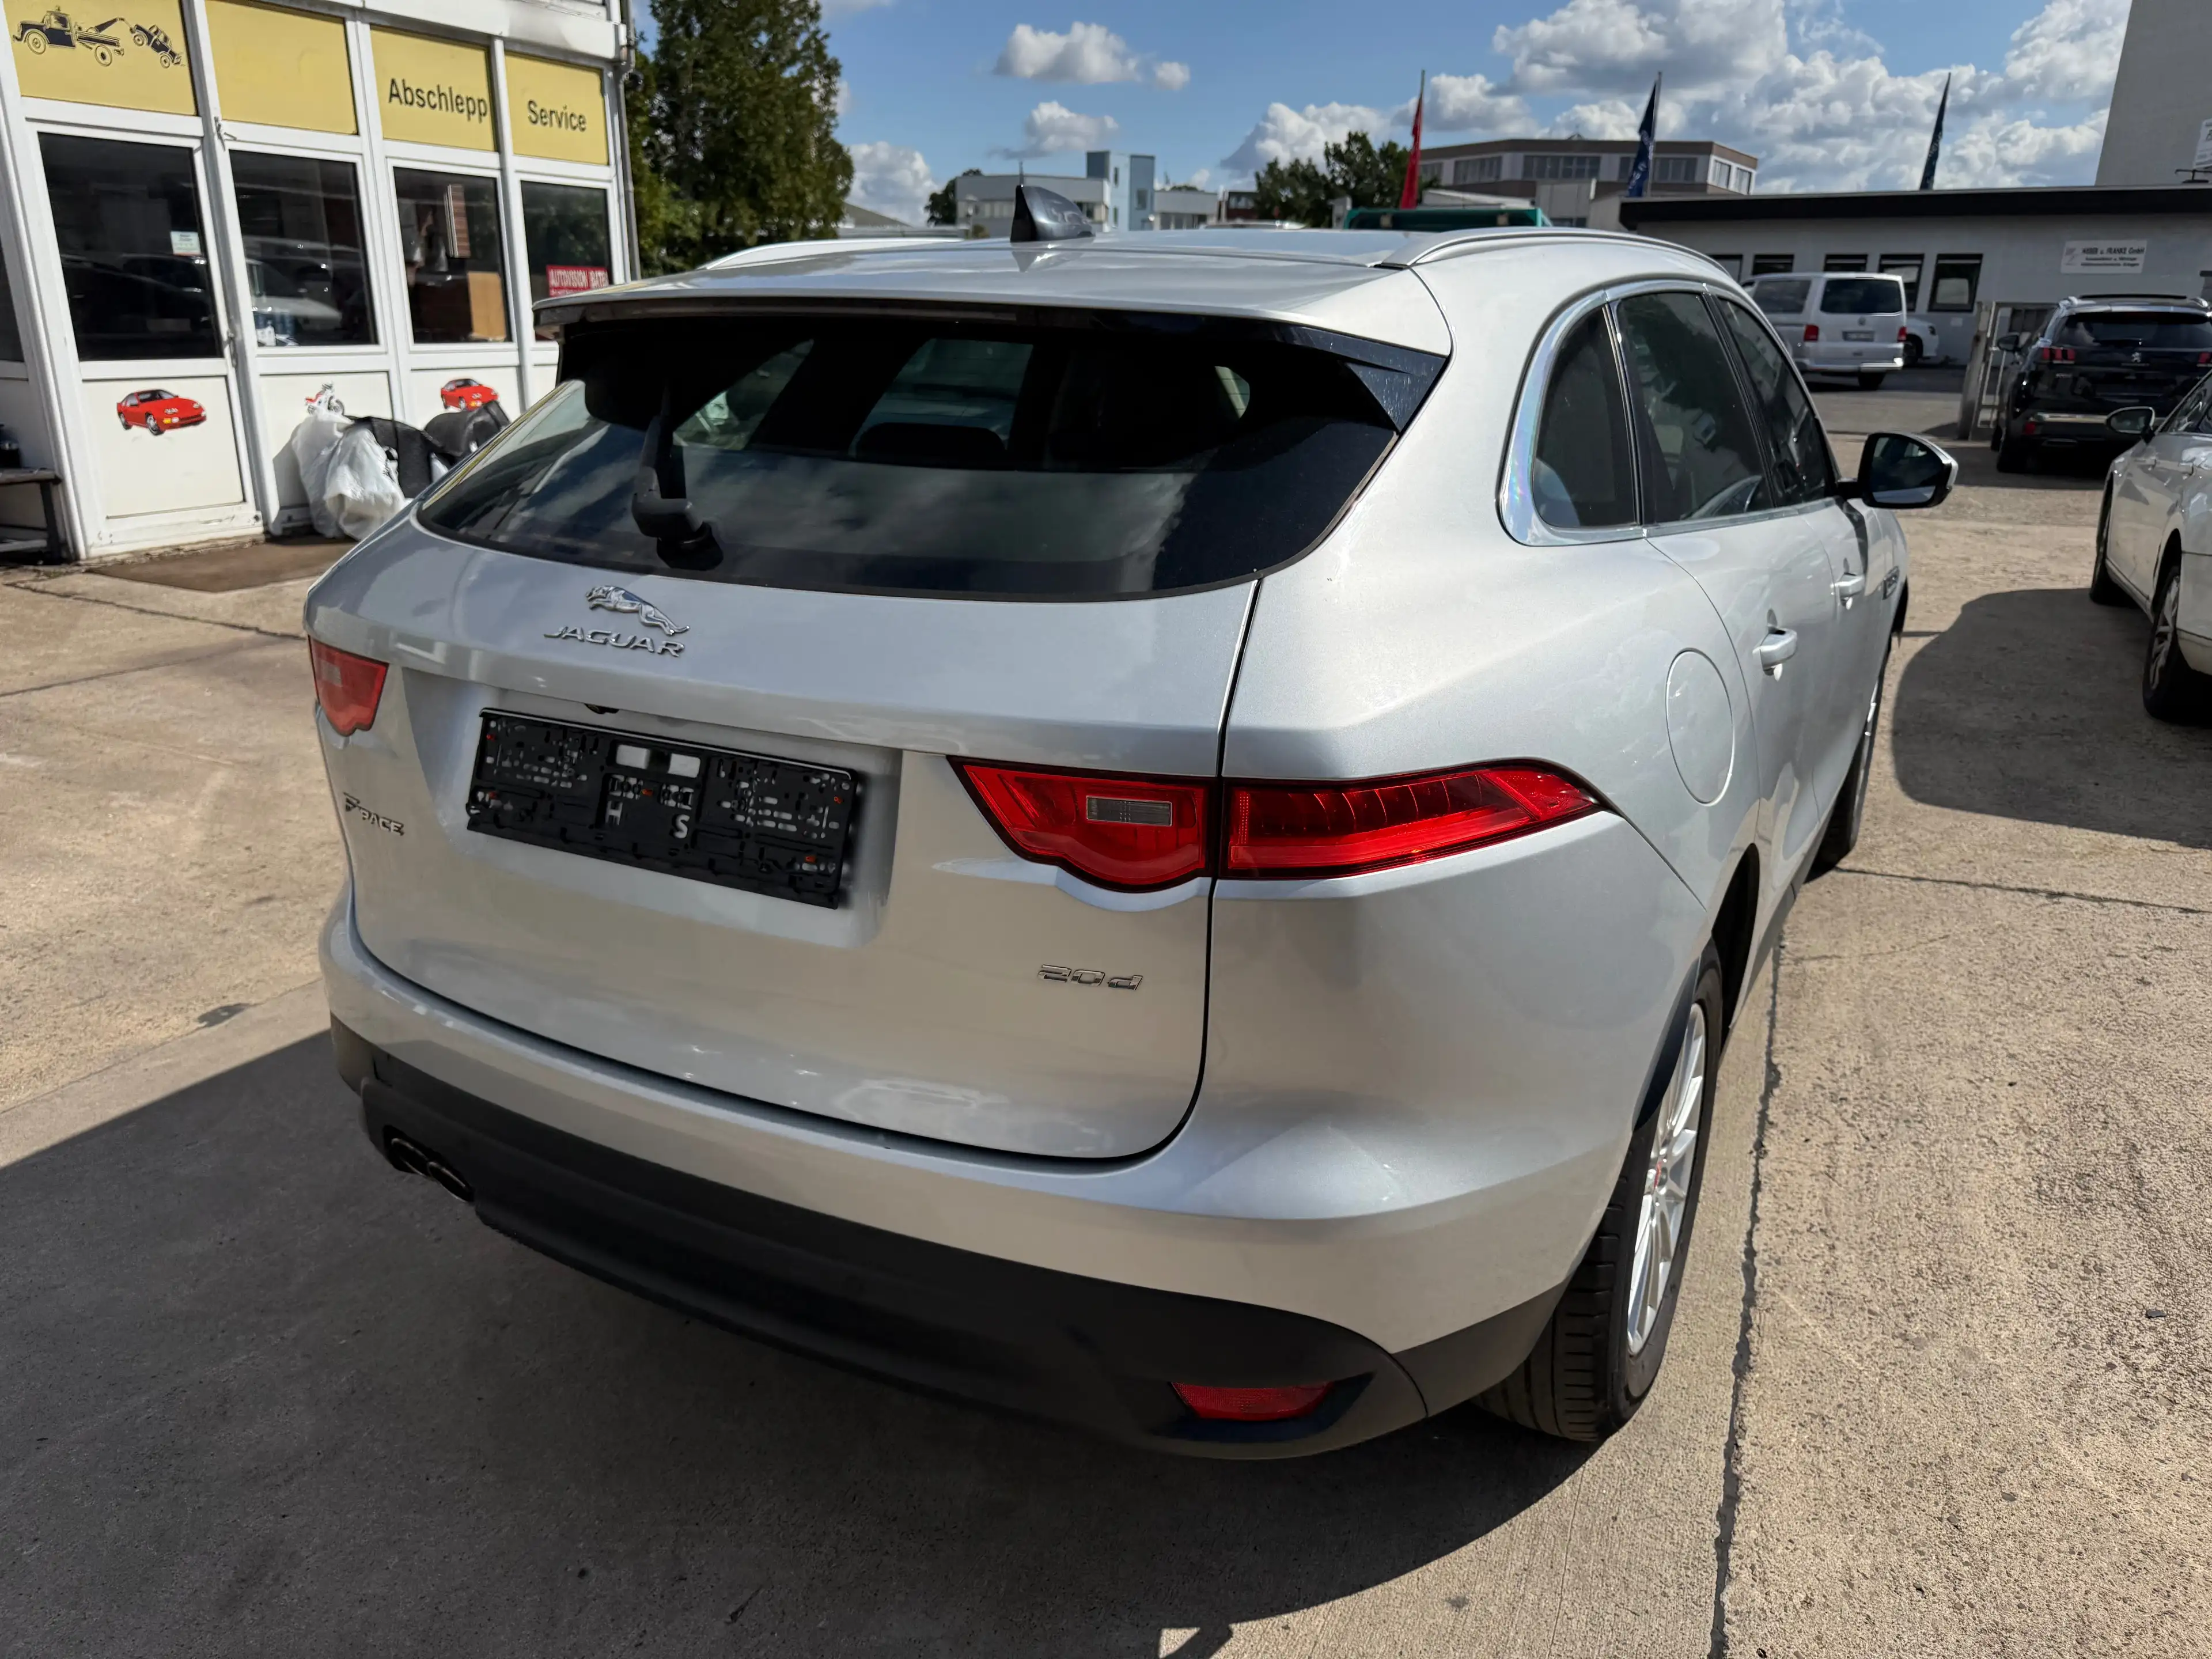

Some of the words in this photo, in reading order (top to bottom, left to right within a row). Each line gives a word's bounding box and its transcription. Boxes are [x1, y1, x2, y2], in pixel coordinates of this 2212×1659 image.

[388, 78, 488, 123] Abschlepp
[527, 100, 587, 132] Service
[544, 626, 685, 657] JAGUAR
[1037, 964, 1143, 990] 20d
